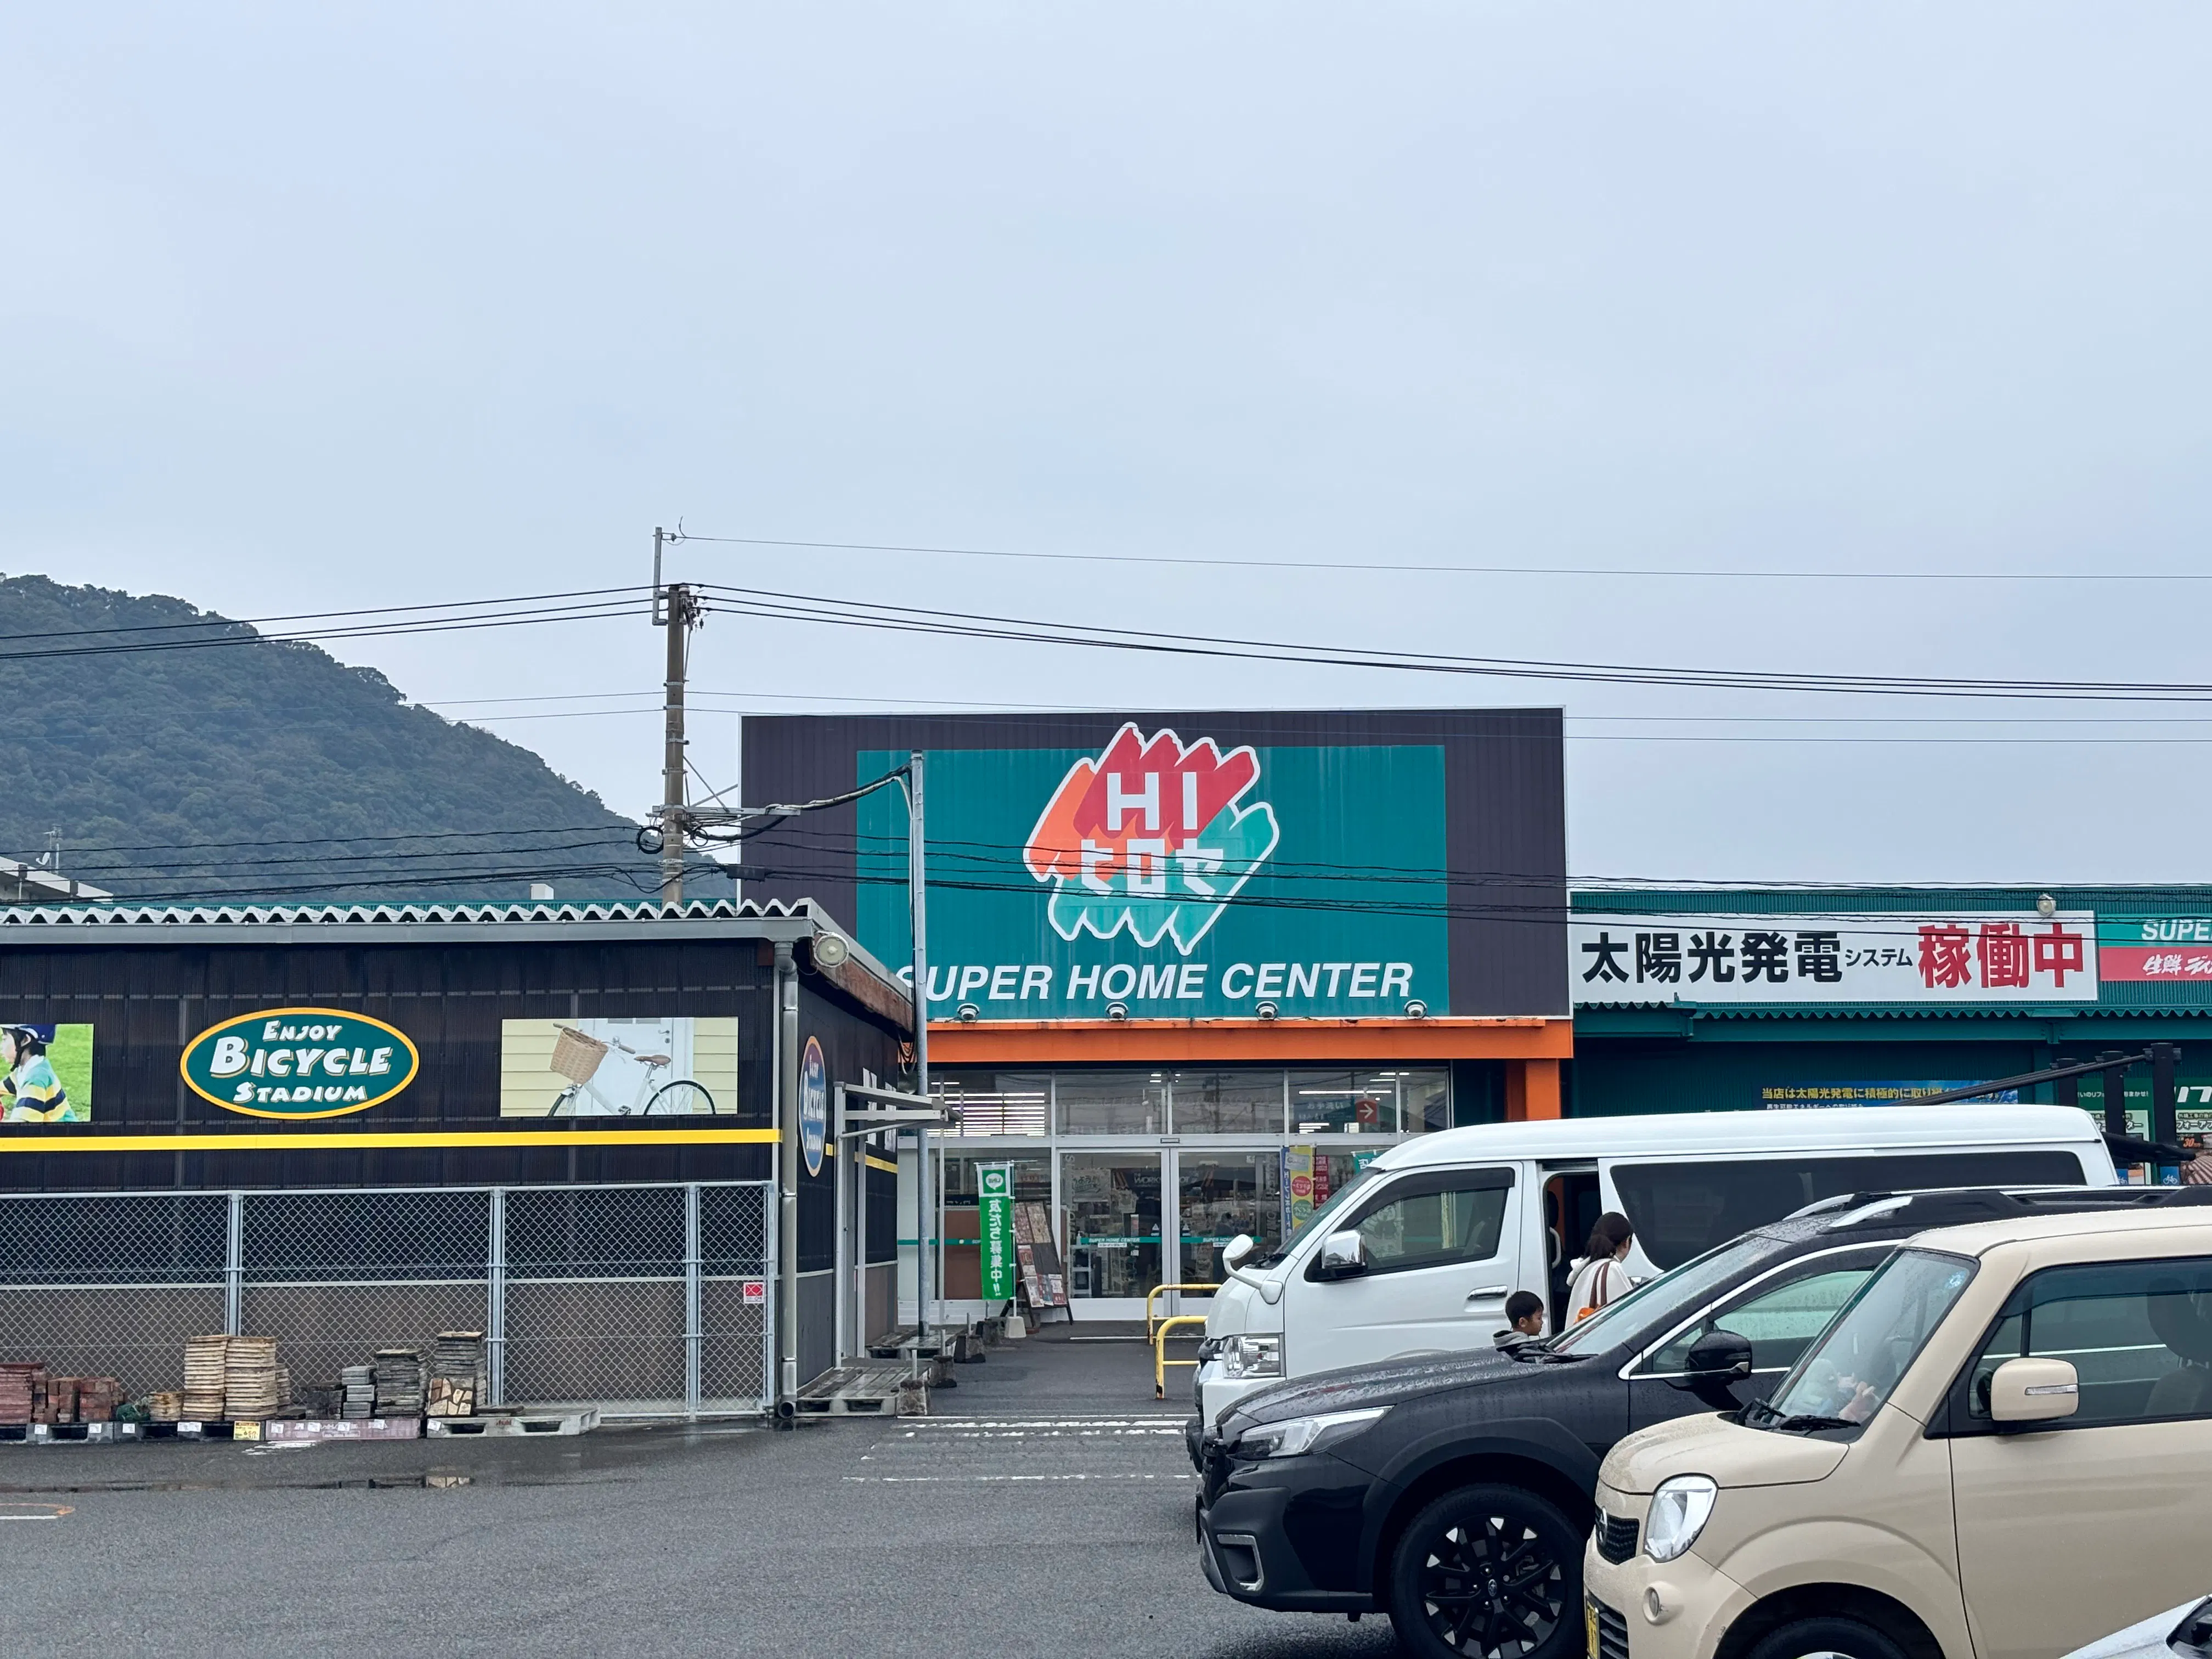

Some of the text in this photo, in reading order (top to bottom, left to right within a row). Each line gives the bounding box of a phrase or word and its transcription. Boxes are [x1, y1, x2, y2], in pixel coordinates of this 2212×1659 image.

[1107, 772, 1199, 831] HI
[1081, 838, 1223, 896] ヒロセ
[2141, 918, 2212, 941] SUPE
[1067, 963, 1207, 1001] HOME
[1221, 962, 1413, 1001] CENTER
[210, 1036, 393, 1077] BICYCLE
[233, 1082, 368, 1104] STADIUM
